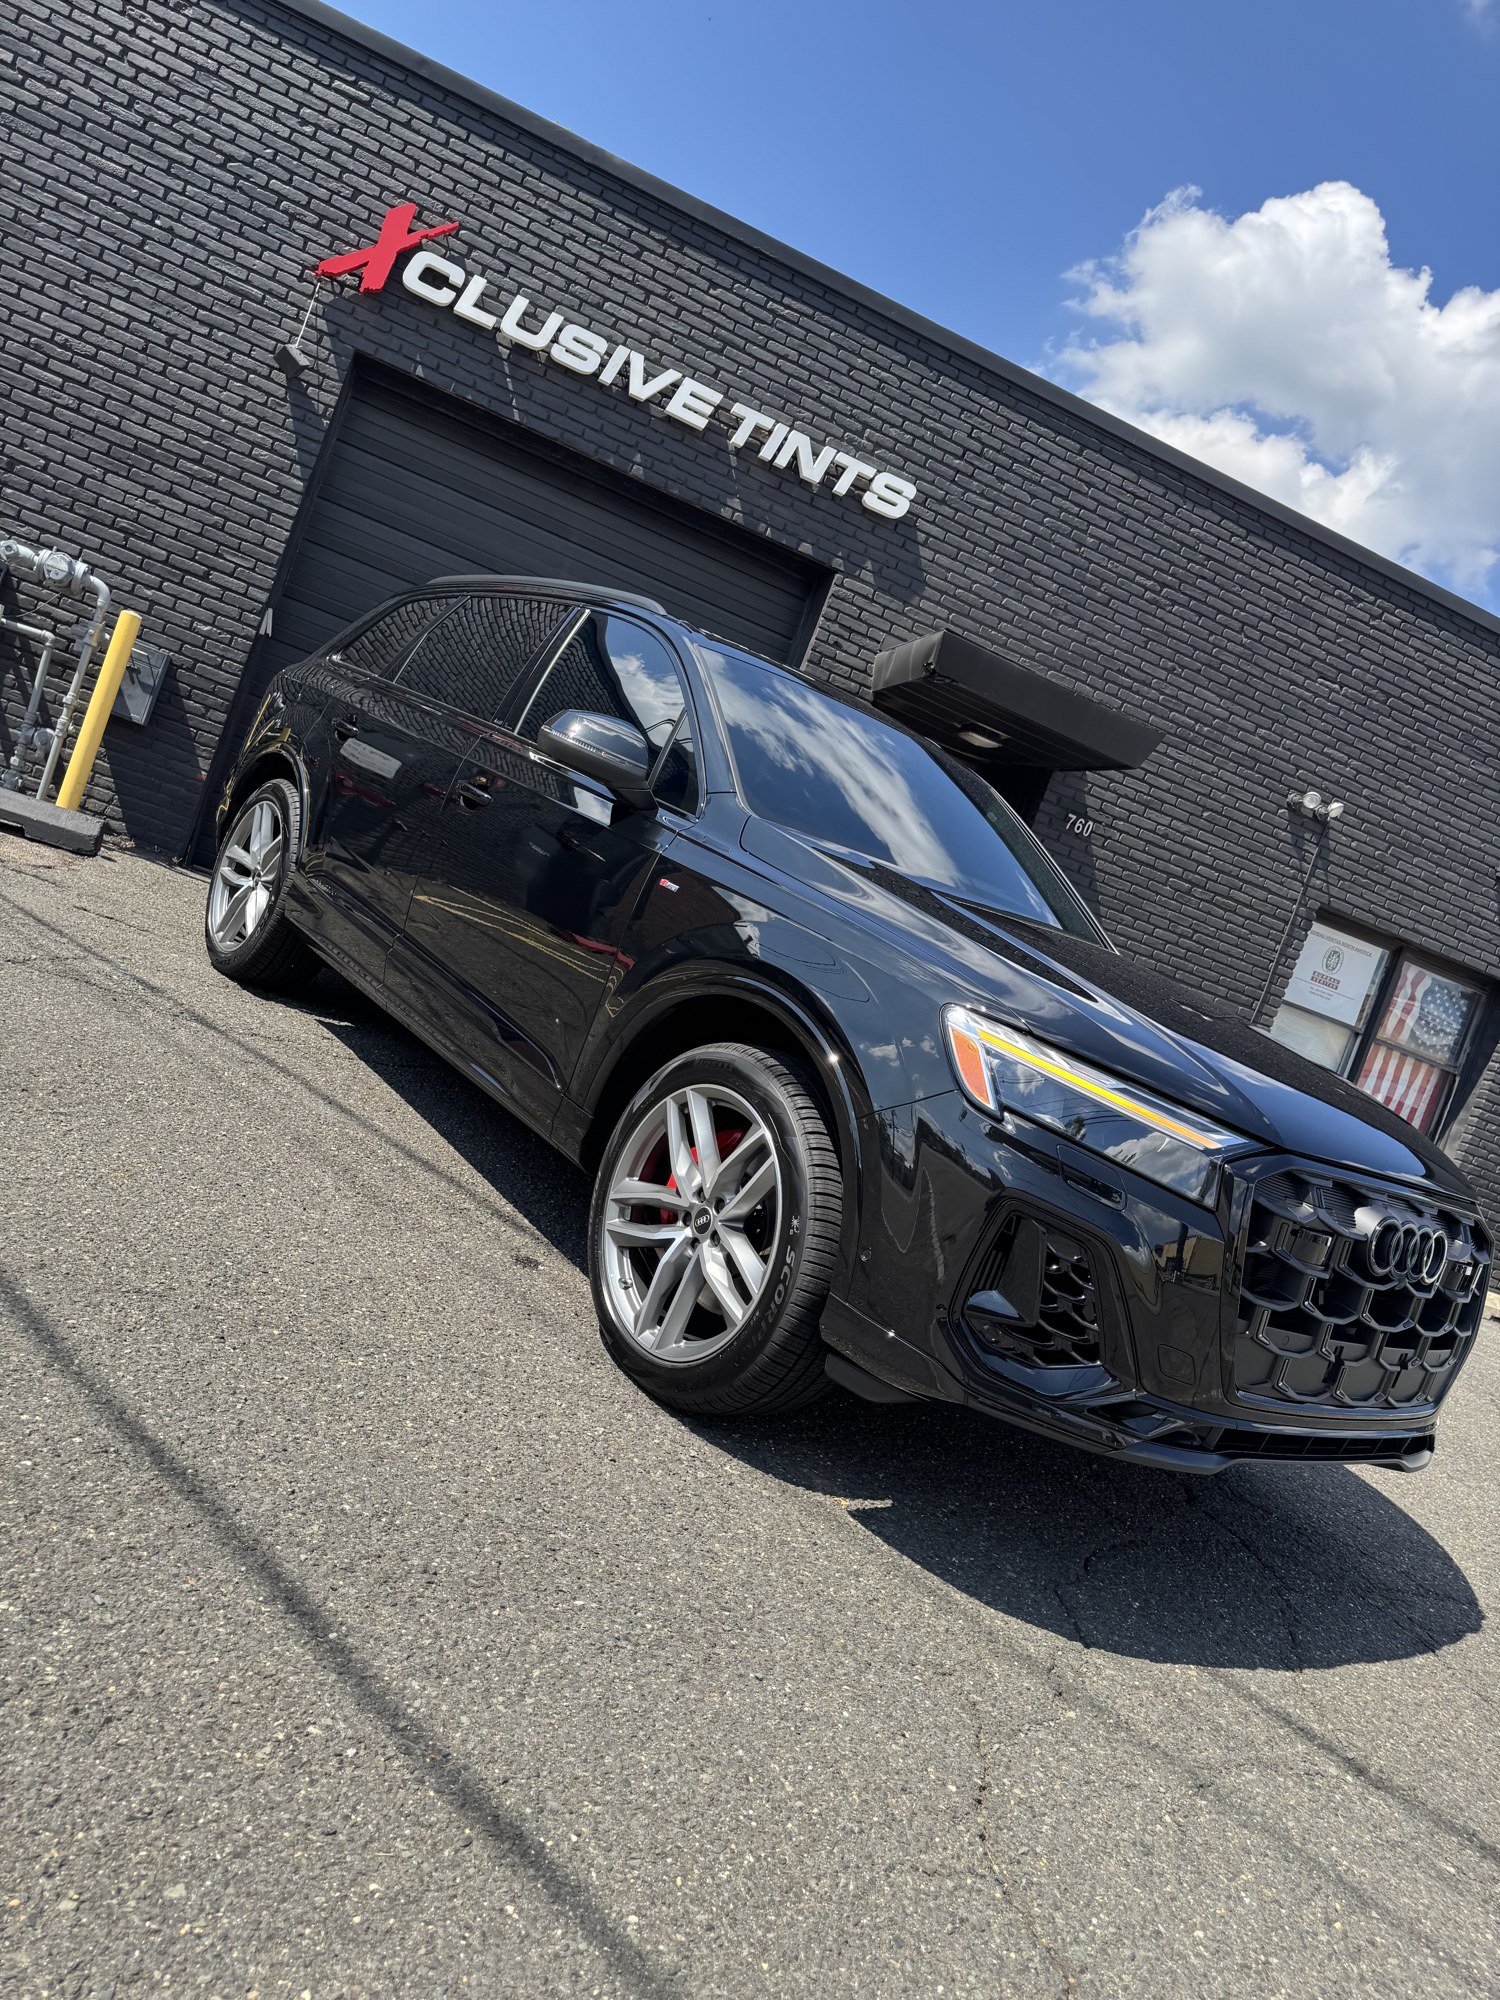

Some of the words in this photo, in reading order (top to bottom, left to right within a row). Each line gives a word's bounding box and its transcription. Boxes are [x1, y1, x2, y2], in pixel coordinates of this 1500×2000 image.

[315, 203, 722, 430] XCLUSIVE
[729, 402, 916, 519] TINTS
[1066, 813, 1093, 837] 760
